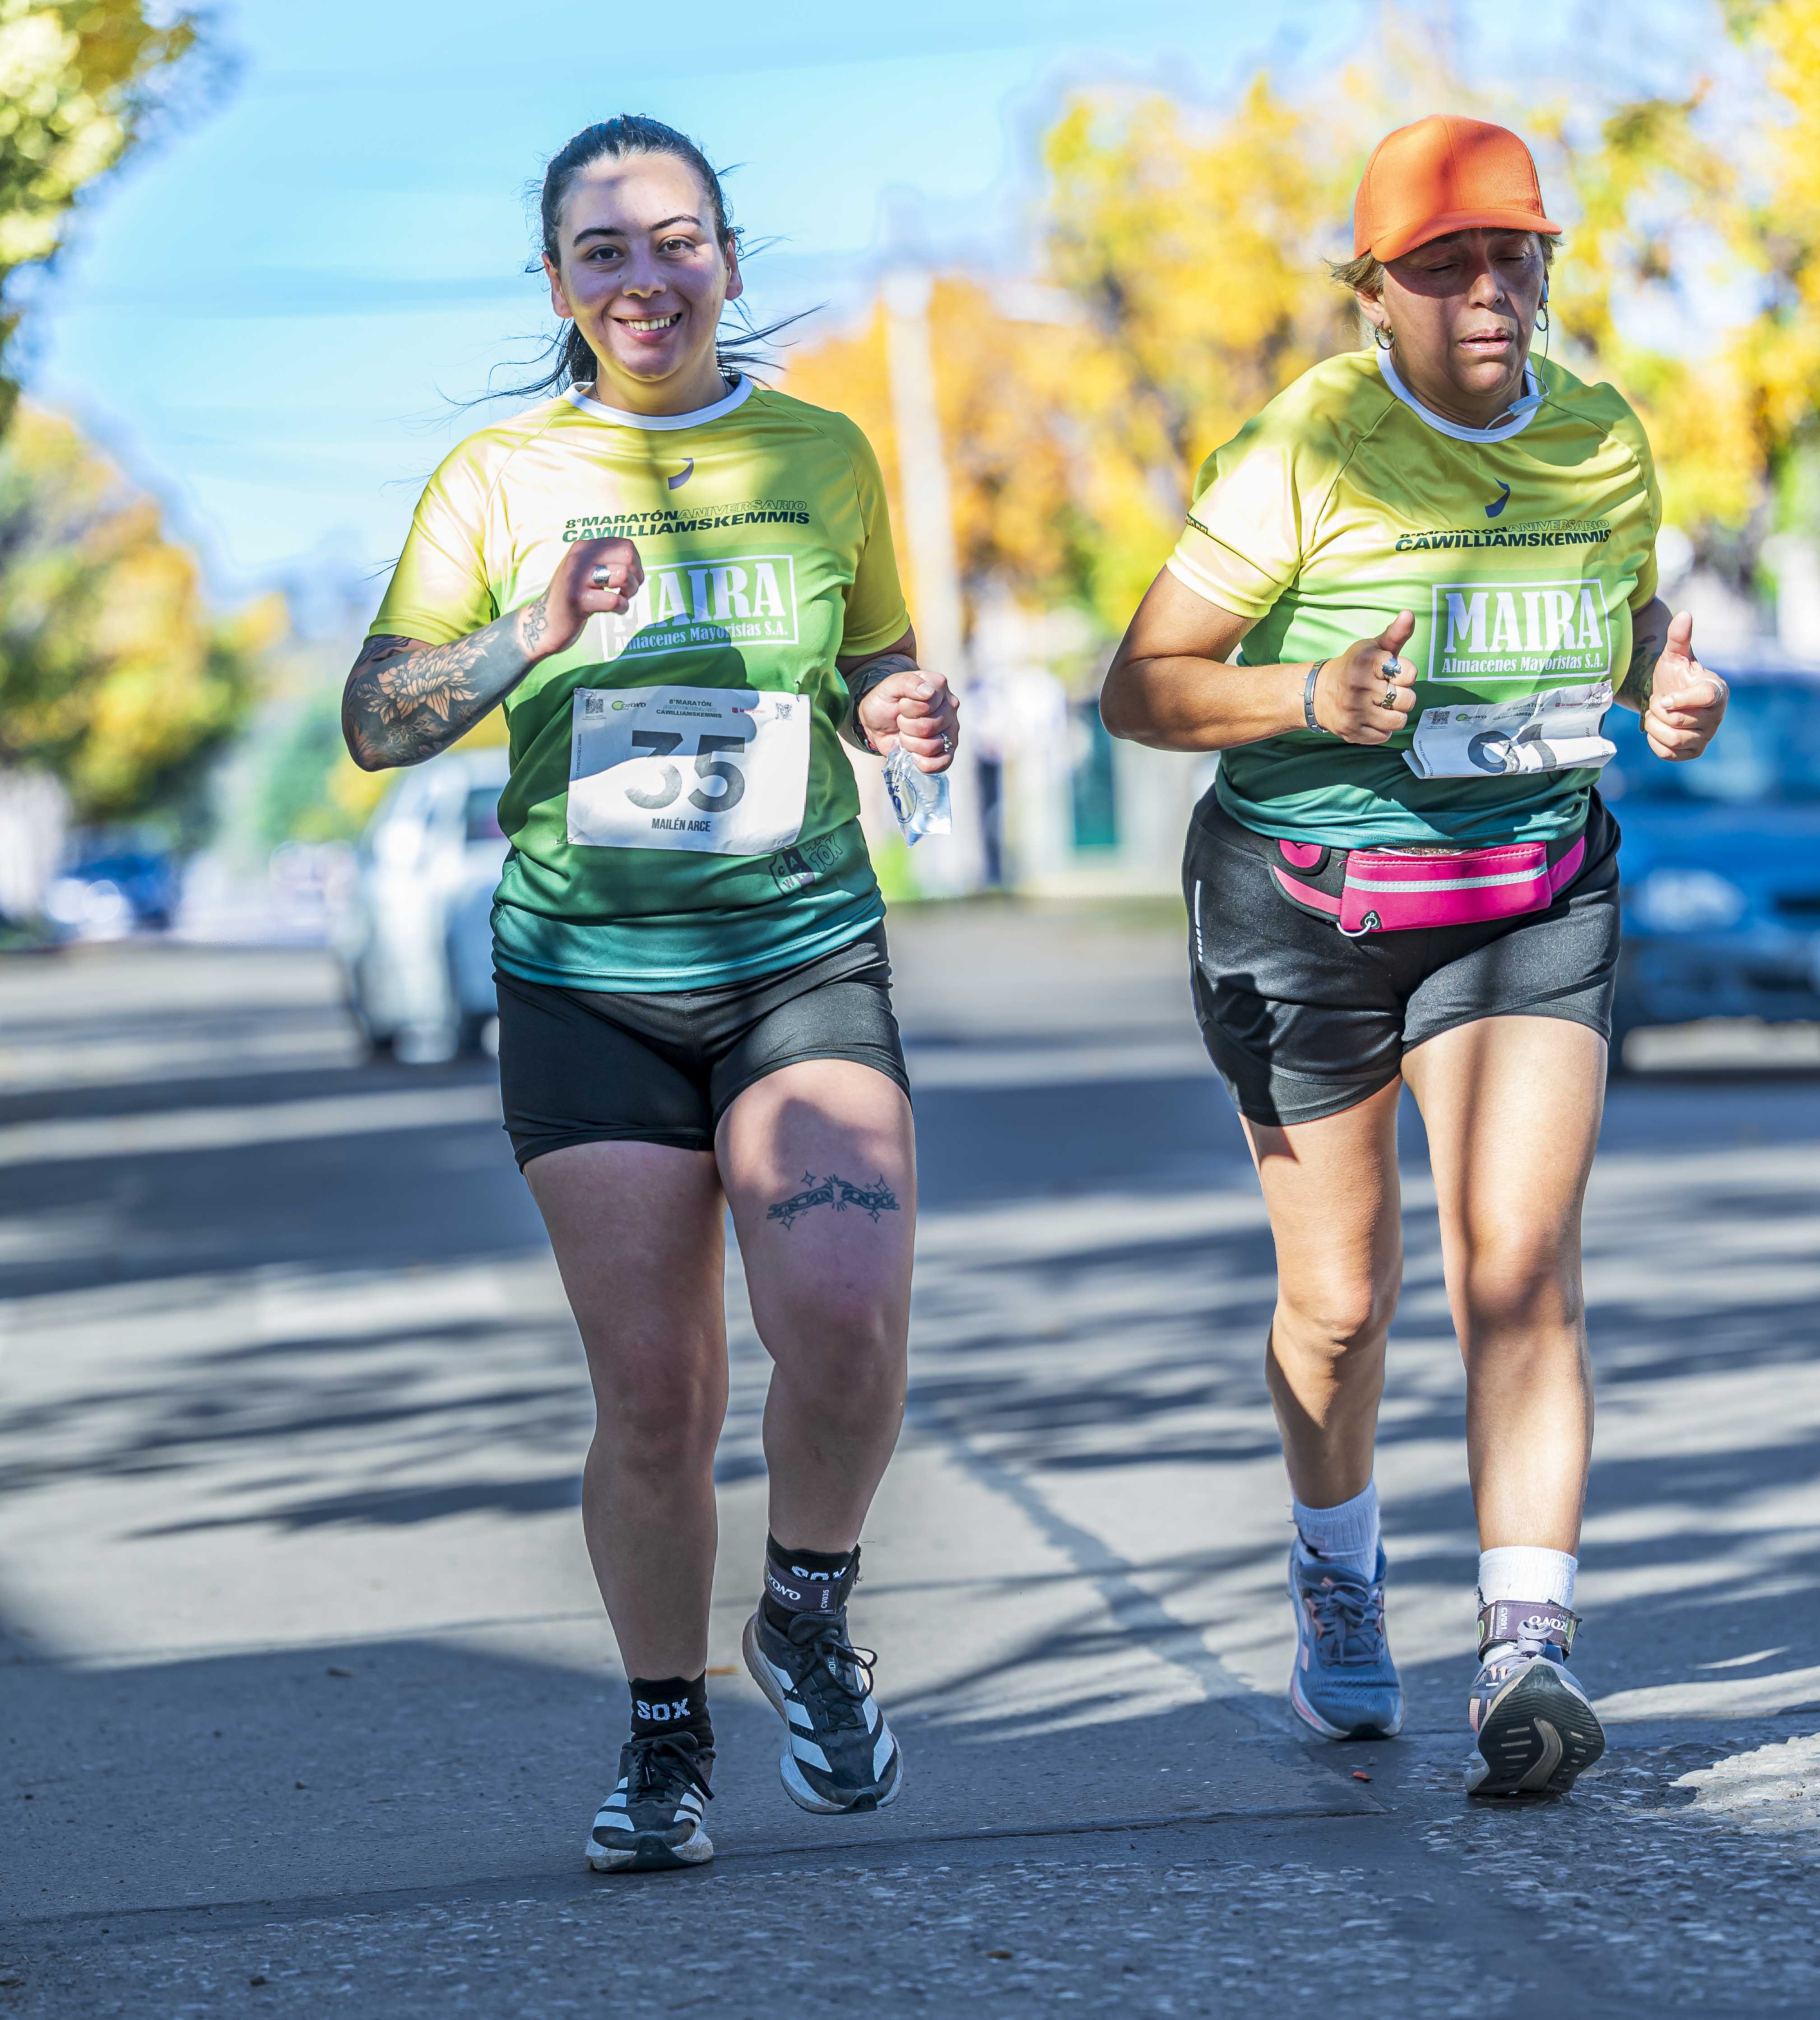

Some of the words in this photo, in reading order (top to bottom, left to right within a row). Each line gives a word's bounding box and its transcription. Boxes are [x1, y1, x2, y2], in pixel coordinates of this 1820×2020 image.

[562, 511, 810, 542] CAWILLIAMSKEMMIS
[1395, 529, 1612, 551] CAWILLIAMSKEMMIS
[1444, 588, 1603, 653] MAIRA
[614, 631, 686, 652] Almacenes
[690, 622, 761, 643] Mayoristas
[765, 621, 789, 636] S.A.
[1442, 657, 1517, 674] Almacenes
[1519, 654, 1583, 673] Mayoristas
[1584, 653, 1603, 668] S.A.
[656, 709, 722, 718] CAWILLIAMSKEMMIS
[624, 730, 745, 813] 35
[651, 817, 686, 831] MAILÉN
[687, 820, 711, 832] ARCE
[809, 833, 843, 873] 10K
[821, 1589, 829, 1608] CV035
[1500, 1607, 1509, 1630] CV091
[636, 1697, 691, 1721] SOX
